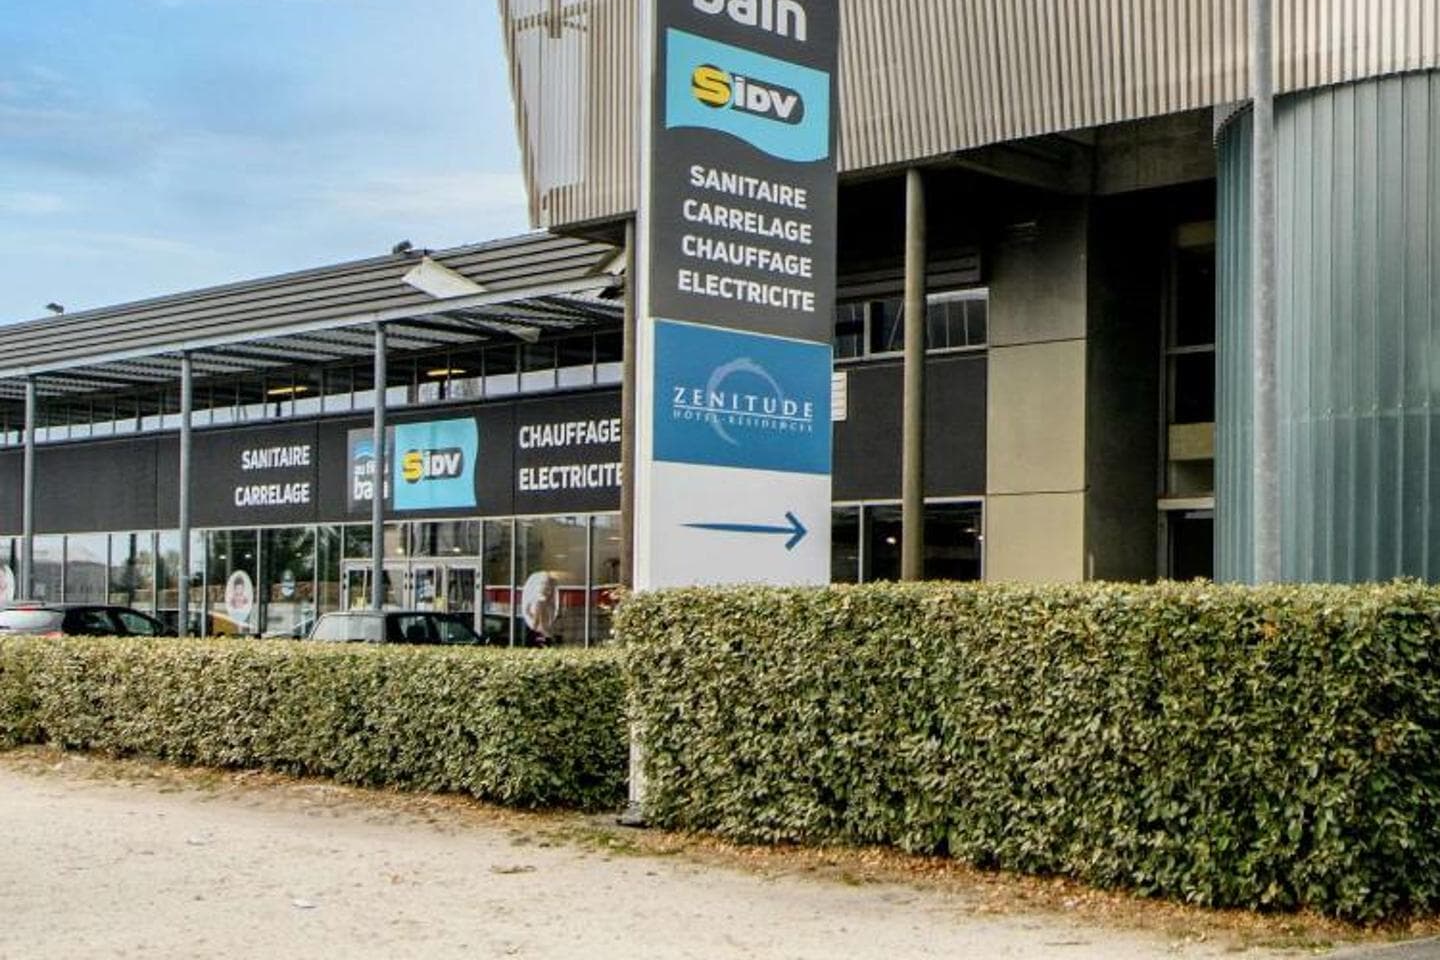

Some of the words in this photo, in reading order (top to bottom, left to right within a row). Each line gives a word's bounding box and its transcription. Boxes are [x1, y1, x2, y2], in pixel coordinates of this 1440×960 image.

[689, 164, 807, 210] SANITAIRE
[682, 198, 812, 244] CARRELAGE
[681, 235, 812, 278] CHAUFFAGE
[677, 269, 815, 312] ELECTRICITE
[673, 387, 814, 418] ZENITUDE
[519, 418, 621, 449] CHAUFFAGE
[241, 444, 311, 471] SANITAIRE
[519, 461, 623, 491] ELECTRICITE
[234, 482, 311, 507] CARRELAGE
